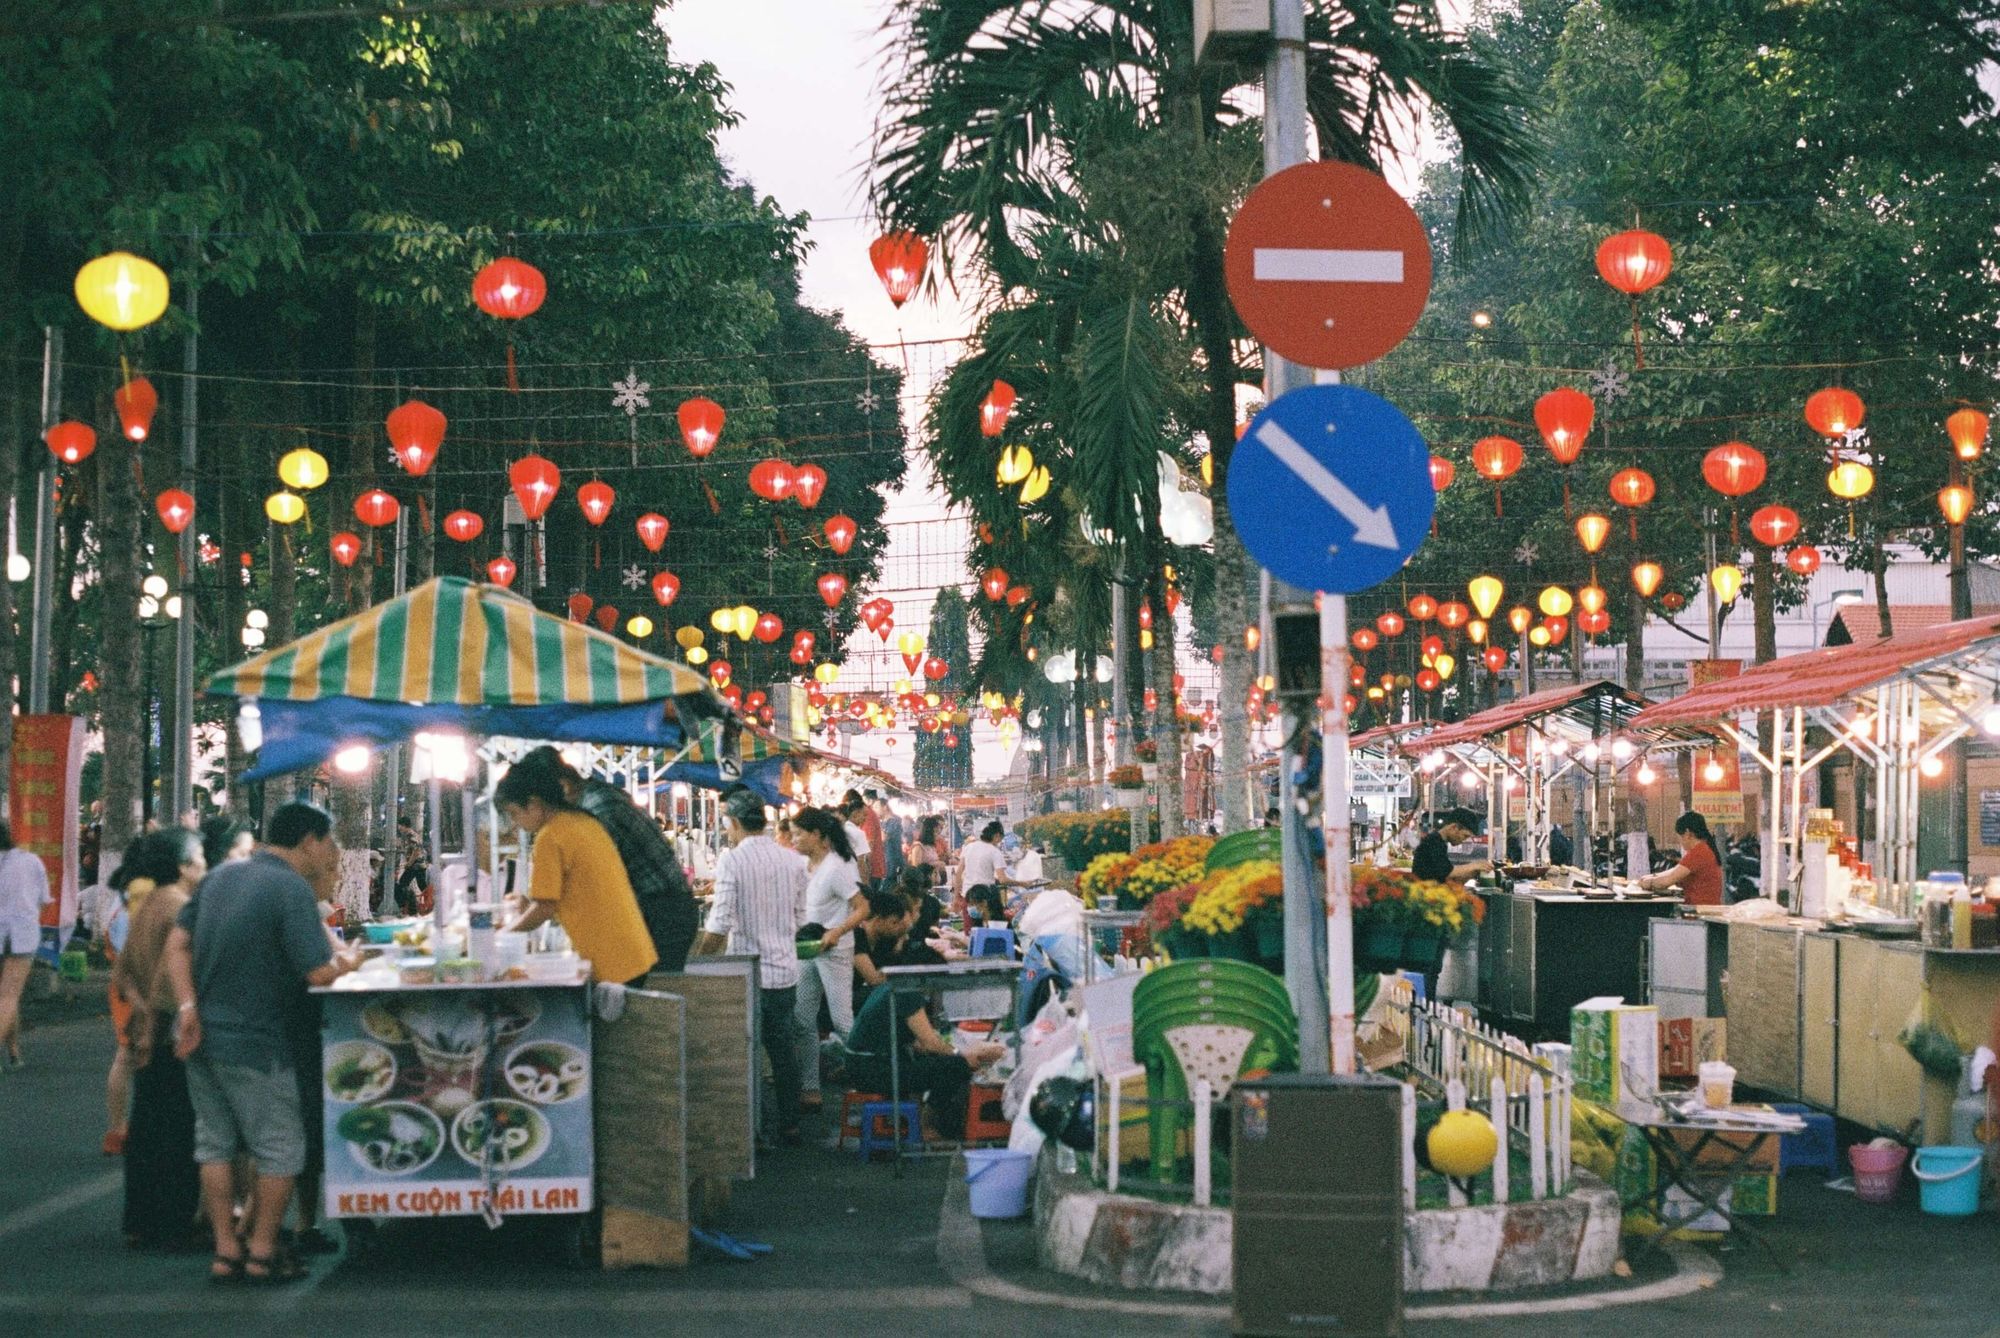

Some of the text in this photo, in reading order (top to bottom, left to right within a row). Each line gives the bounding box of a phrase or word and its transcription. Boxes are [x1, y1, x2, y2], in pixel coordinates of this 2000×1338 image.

[338, 1193, 390, 1213] KEM
[396, 1187, 461, 1216] CUỘN
[532, 1189, 578, 1210] LAN
